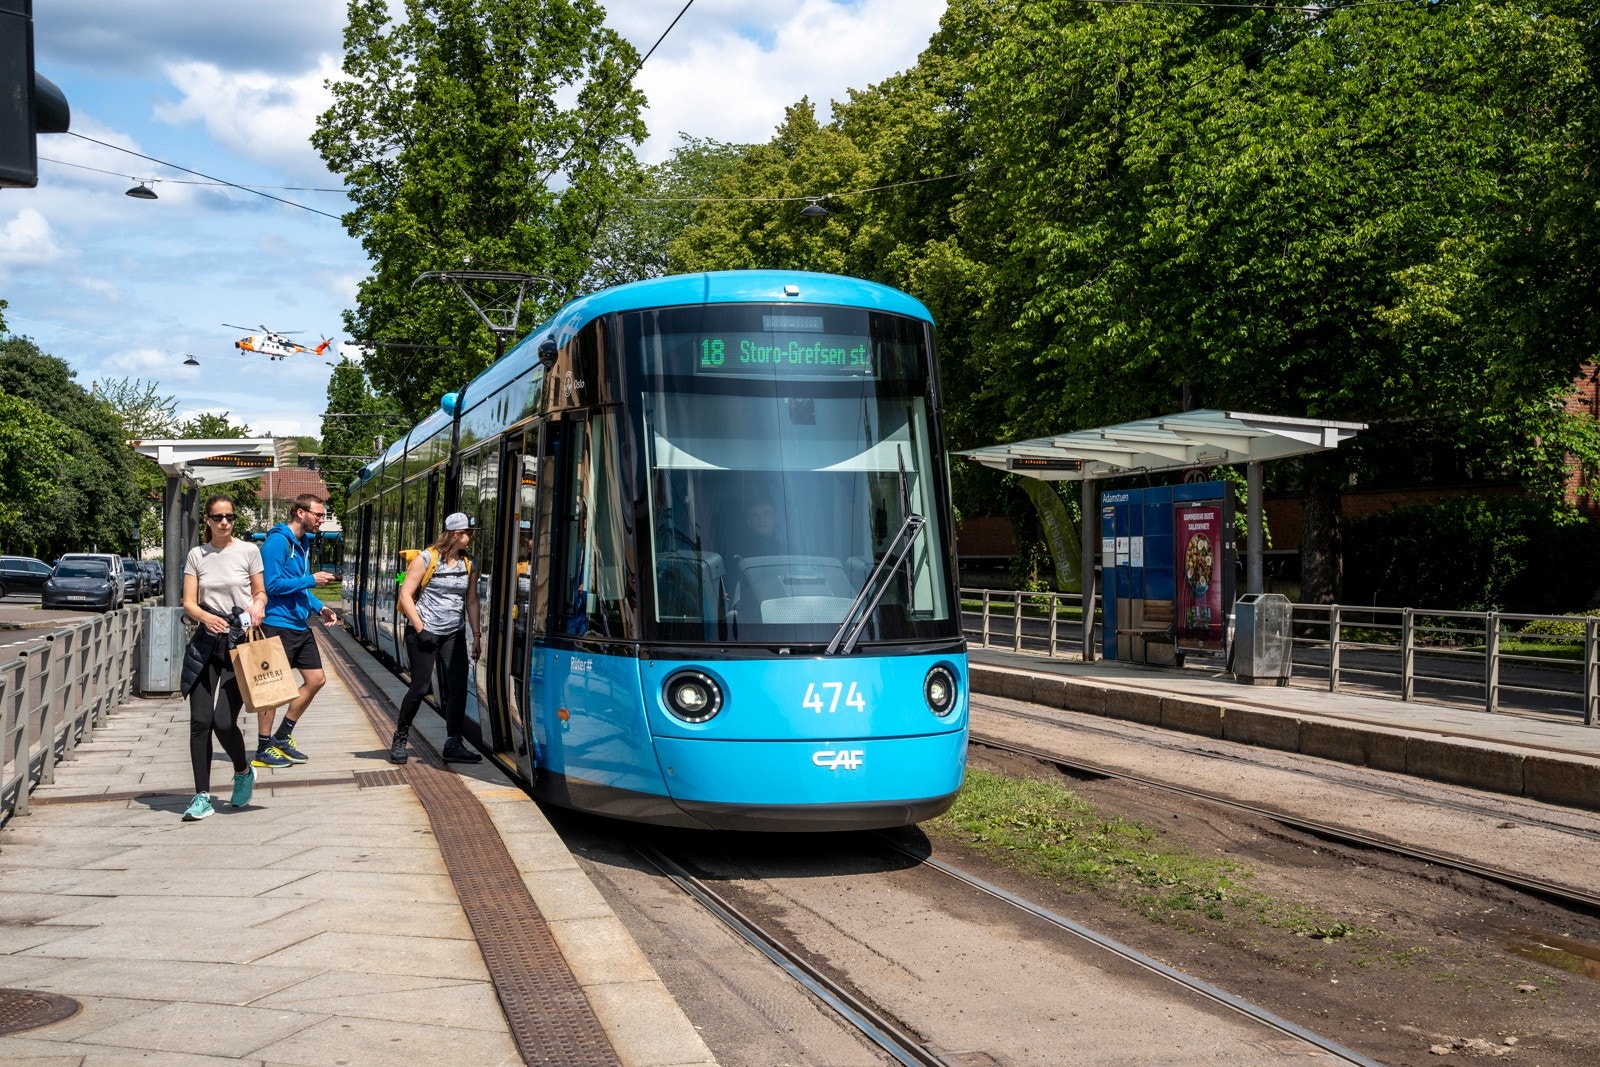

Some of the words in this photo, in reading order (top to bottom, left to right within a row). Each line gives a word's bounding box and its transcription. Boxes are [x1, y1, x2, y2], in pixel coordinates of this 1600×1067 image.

[701, 339, 725, 366] 18
[740, 340, 846, 364] Storo-Grefsen
[1102, 493, 1129, 503] Adamstuen
[253, 669, 283, 682] KOLIBRI
[802, 681, 866, 714] 474
[812, 749, 864, 770] CAF
